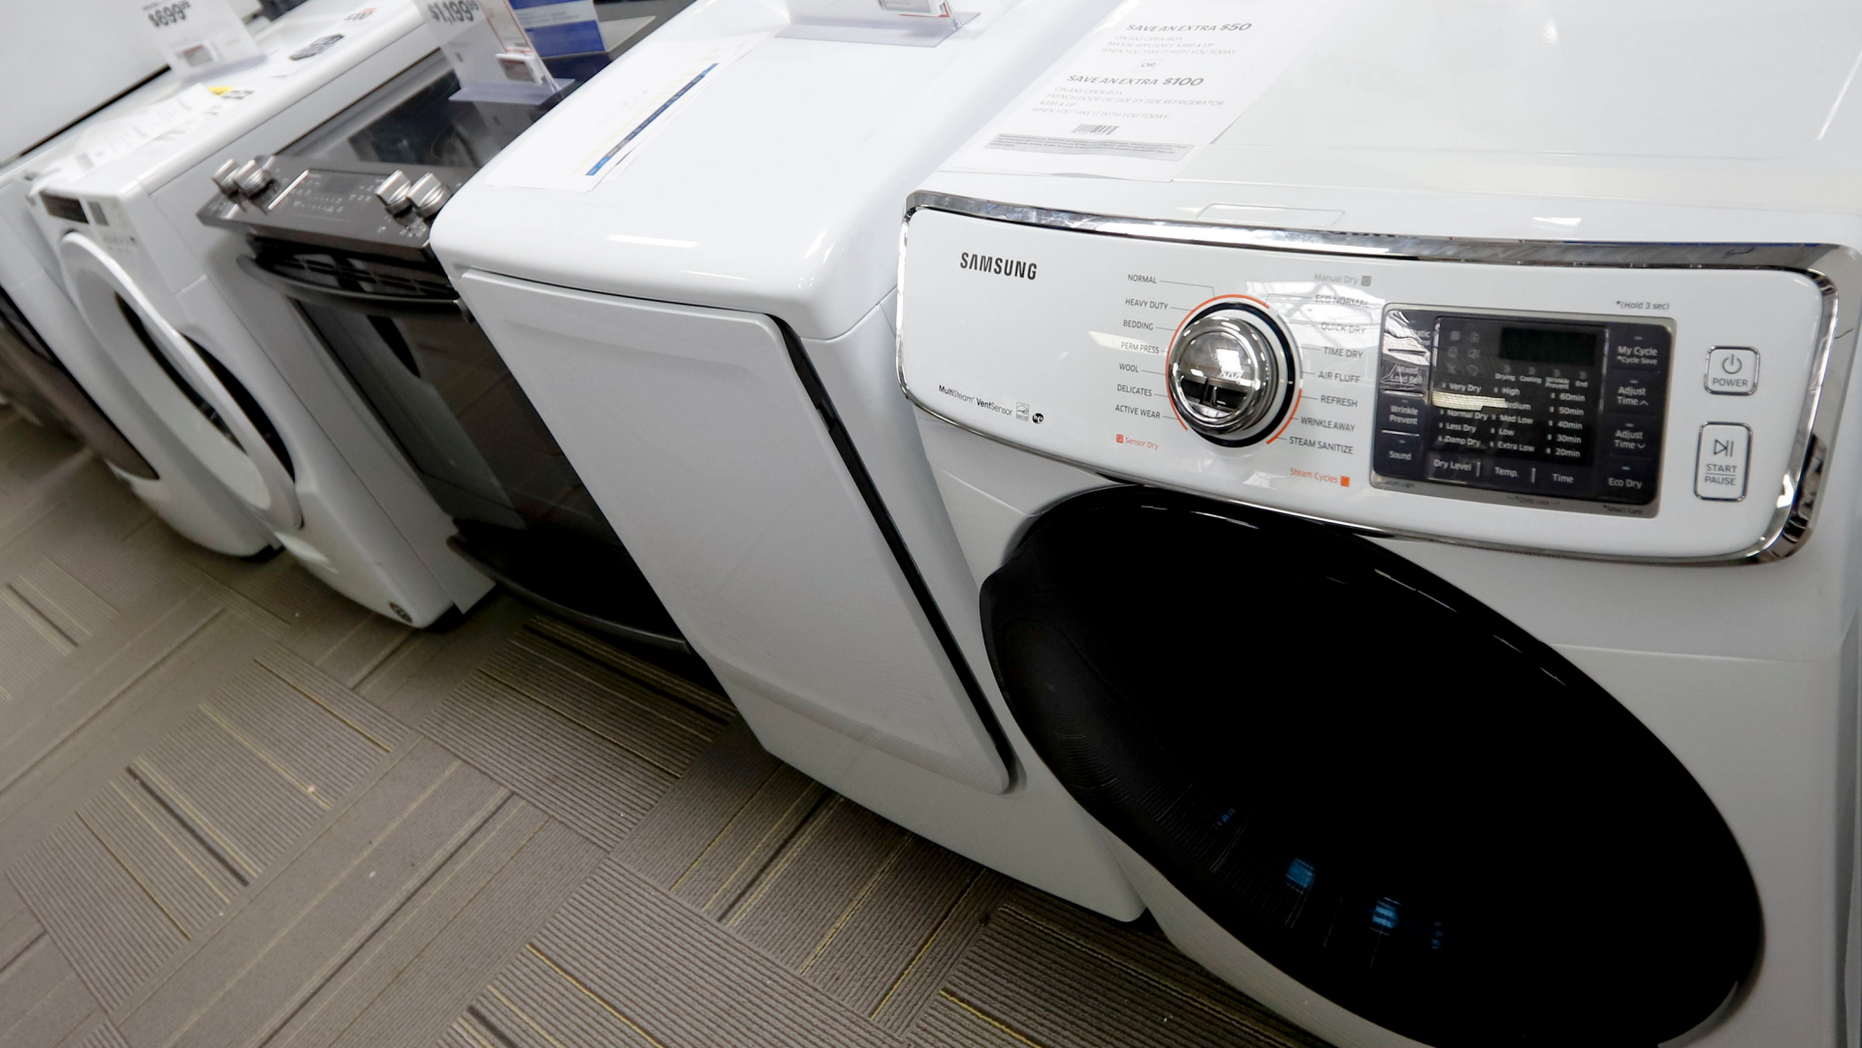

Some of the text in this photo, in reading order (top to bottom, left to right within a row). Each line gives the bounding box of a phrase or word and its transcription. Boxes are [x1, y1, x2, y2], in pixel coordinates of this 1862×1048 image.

[1219, 23, 1253, 31] $50
[1066, 75, 1101, 83] SAVE
[1118, 78, 1159, 86] EXTRA
[1162, 77, 1205, 86] $100
[960, 252, 1037, 280] SAMSUNG
[1127, 274, 1157, 284] NORMAL
[1314, 273, 1359, 285] Manual Dry
[1125, 298, 1168, 310] HEAVY DUTY
[1315, 294, 1368, 307] ECO NORMAL
[1645, 302, 1651, 310] 3
[1652, 302, 1670, 311] sec)
[1123, 319, 1154, 330] BEDDING
[1321, 322, 1367, 334] QUICK DRY
[1120, 341, 1159, 354] PERM PRESS
[1323, 346, 1364, 359] TIME DRY
[1617, 345, 1658, 356] My Cycle
[1641, 357, 1658, 365] Save
[1119, 363, 1139, 373] WOOL
[1396, 365, 1419, 374] Mixed
[1318, 371, 1361, 383] AIR FLUFF
[1495, 373, 1516, 382] Drying
[1520, 375, 1542, 384] Cooling
[1546, 376, 1570, 384] Wrinkle
[1712, 377, 1748, 388] POWER
[1449, 383, 1481, 394] Very Dry
[1545, 382, 1570, 390] Prevent
[1575, 380, 1588, 388] End
[1117, 384, 1152, 397] DELICATES
[1502, 387, 1520, 396] High
[1618, 386, 1647, 396] Adjust
[1320, 395, 1358, 407] REFRESH
[1559, 393, 1586, 402] 60min
[1616, 395, 1639, 406] Time
[976, 397, 1012, 416] VentSensor
[1115, 404, 1160, 419] ACTIVE WEAR
[1390, 405, 1419, 416] Wrinkle
[1558, 406, 1584, 416] 50min
[1389, 414, 1418, 425] Prevent
[1447, 409, 1488, 421] Normal Dry
[1500, 414, 1534, 424] Med Low
[1301, 416, 1356, 432] WRINKLE AWAY
[1446, 422, 1477, 434] Less Dry
[1557, 420, 1583, 430] 40min
[1498, 428, 1515, 436] Low
[1615, 430, 1643, 440] Adjust
[1125, 437, 1159, 451] Sensor Dry
[1445, 436, 1481, 448] Damp Dry
[1556, 434, 1582, 444] 30min
[1614, 439, 1636, 449] Time
[1289, 436, 1354, 455] STEAM SANITIZE
[1497, 441, 1535, 452] Extra Low
[1389, 450, 1412, 460] Sound
[1555, 448, 1581, 458] 20min
[1433, 459, 1472, 471] Dry Level
[1706, 463, 1738, 473] START
[1290, 467, 1338, 484] Steam Cycles
[1494, 466, 1519, 478] Temp.
[1552, 473, 1575, 484] Time
[1608, 477, 1643, 489] Eco Dry
[1704, 475, 1736, 486] PAUSE
